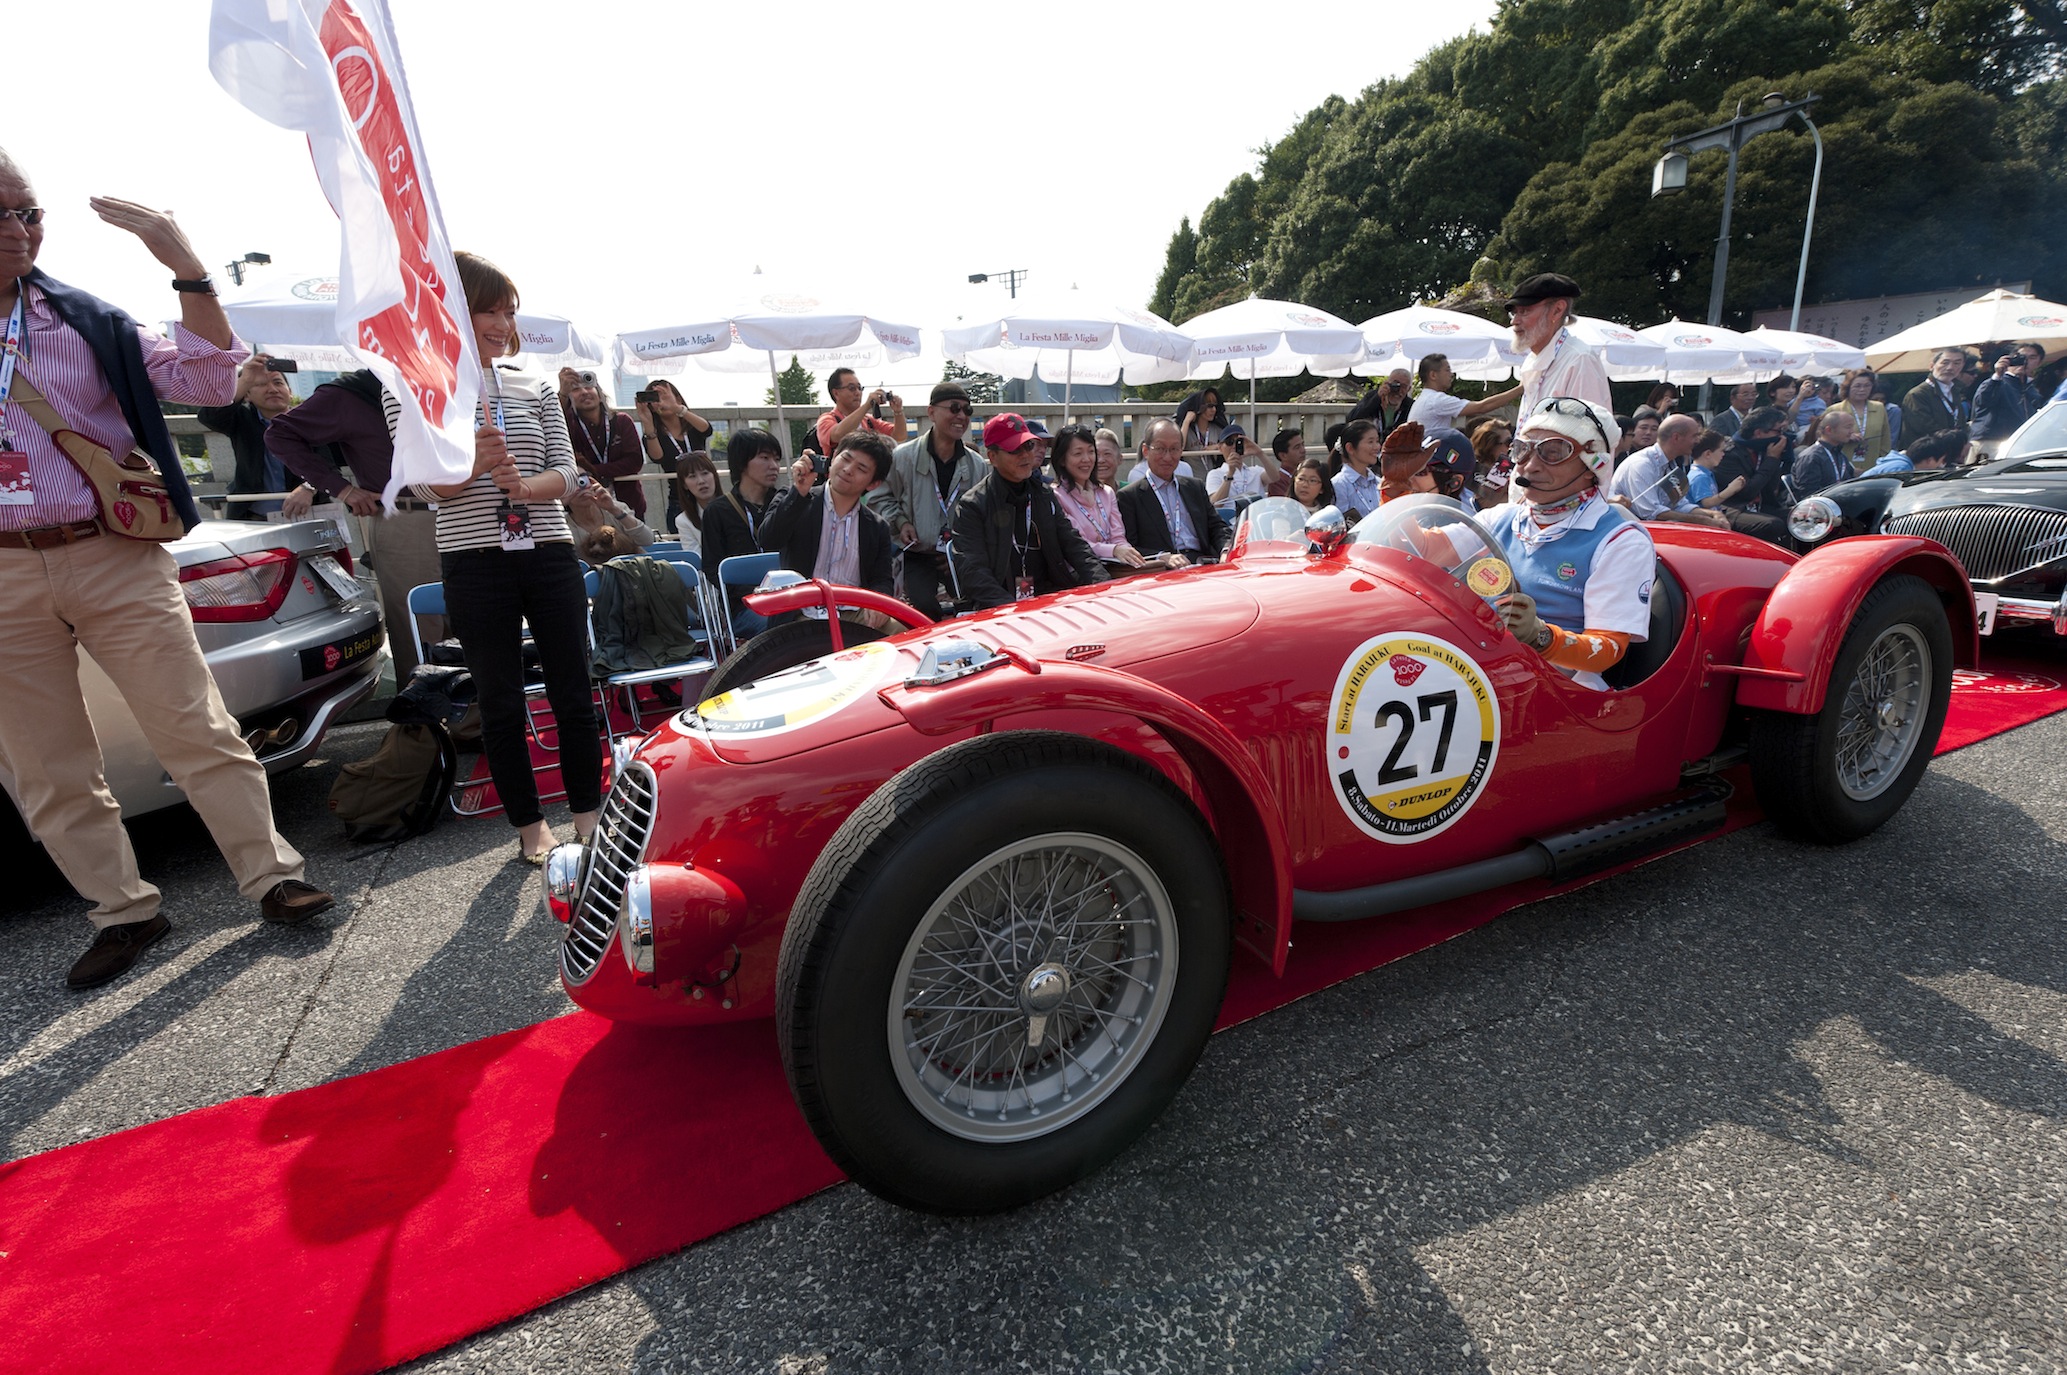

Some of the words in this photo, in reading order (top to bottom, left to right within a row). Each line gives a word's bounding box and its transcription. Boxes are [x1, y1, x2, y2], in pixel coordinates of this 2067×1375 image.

[521, 332, 554, 345] Miglia
[635, 343, 646, 353] La
[647, 341, 668, 351] Festa
[669, 337, 690, 348] Mille
[691, 334, 716, 346] Miglia
[1019, 332, 1030, 341] La
[1032, 332, 1052, 341] Festa
[1053, 332, 1073, 342] Mille
[1075, 333, 1099, 343] Miglia
[1198, 348, 1207, 356] La
[1208, 347, 1226, 355] Festa
[1227, 345, 1245, 353] Mille
[1246, 344, 1268, 353] Miglia
[344, 646, 354, 659] La
[354, 639, 370, 655] Festa
[1351, 645, 1392, 687] HARAJUKU
[1396, 662, 1422, 675] 1000
[1407, 643, 1431, 654] Goal
[1433, 651, 1443, 659] at
[1445, 653, 1488, 705] HARAJUKU
[1348, 688, 1356, 700] at
[732, 720, 765, 731] 2011
[1340, 701, 1352, 731] Start
[1375, 689, 1458, 787] 27
[1399, 787, 1452, 807] DUNLOP
[1439, 785, 1472, 820] Ottobre
[1470, 757, 1487, 785] 2011
